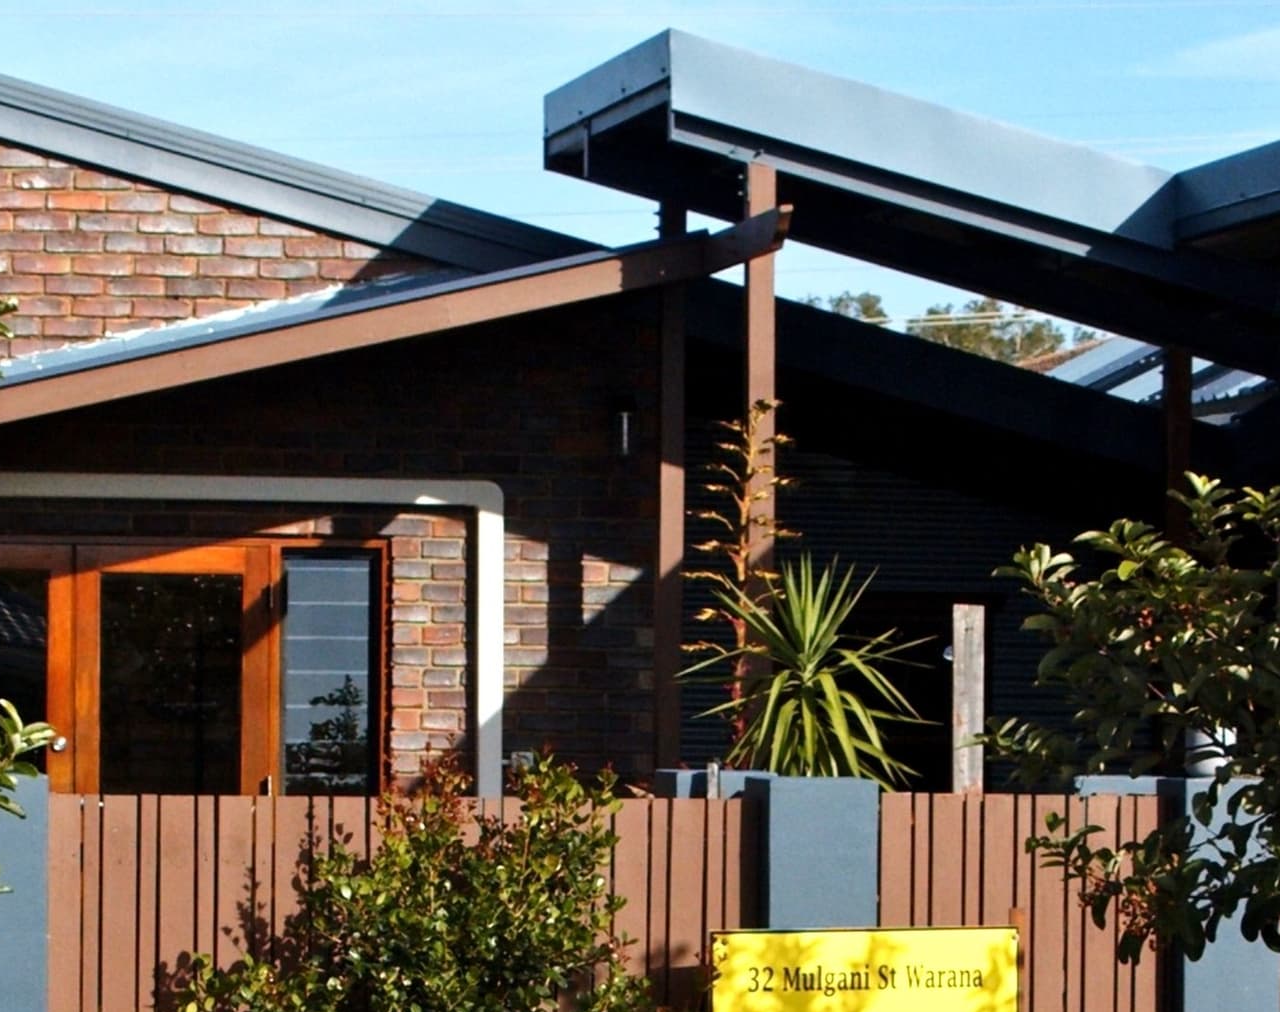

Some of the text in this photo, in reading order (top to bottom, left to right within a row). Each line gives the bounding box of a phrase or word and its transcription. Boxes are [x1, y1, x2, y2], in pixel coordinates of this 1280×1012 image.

[747, 963, 984, 997] 32 Mulgani St Warana
